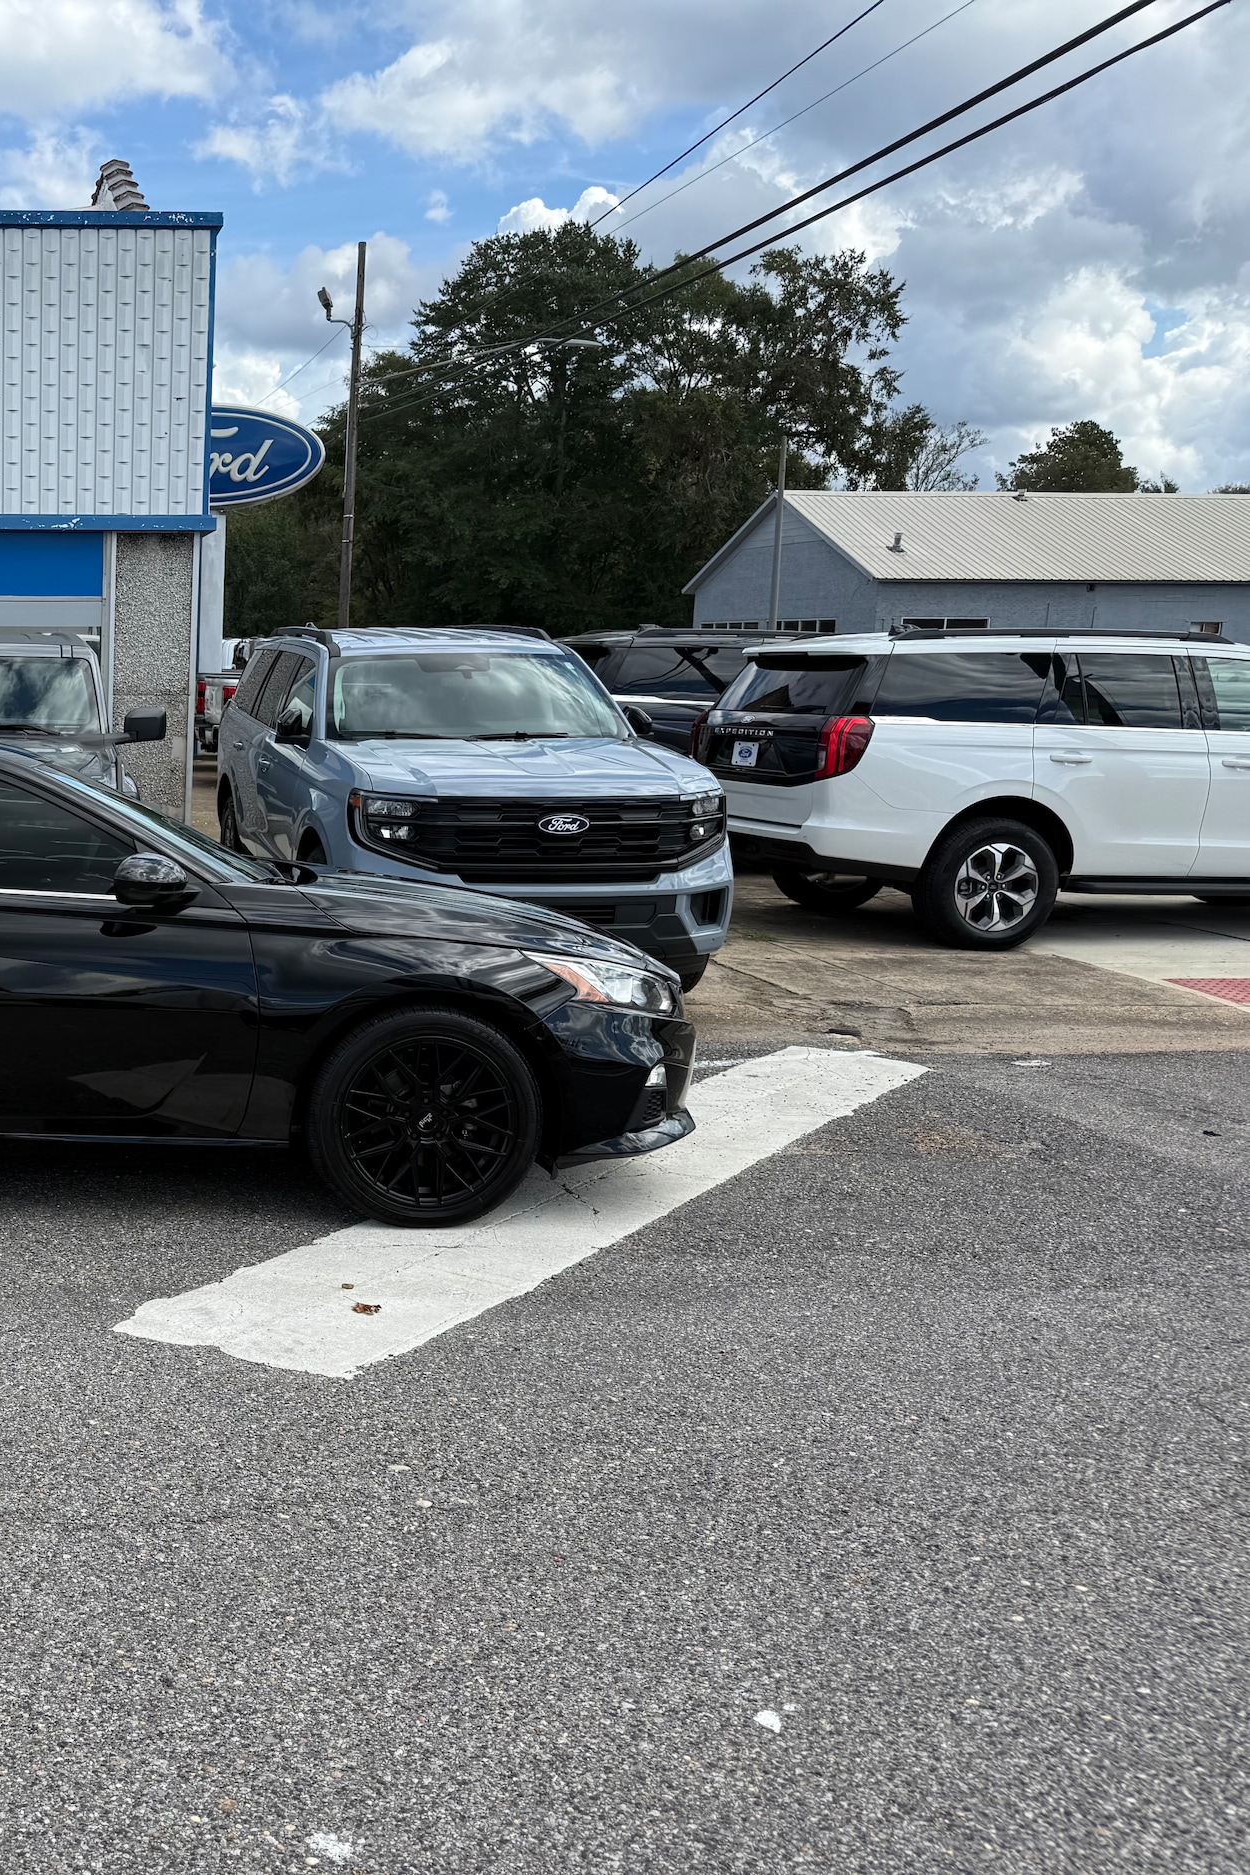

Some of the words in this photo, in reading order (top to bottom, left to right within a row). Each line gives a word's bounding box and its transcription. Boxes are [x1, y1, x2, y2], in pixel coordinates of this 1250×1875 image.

[210, 426, 274, 483] rd
[714, 727, 774, 737] EXPEDITION
[548, 817, 580, 831] Ford
